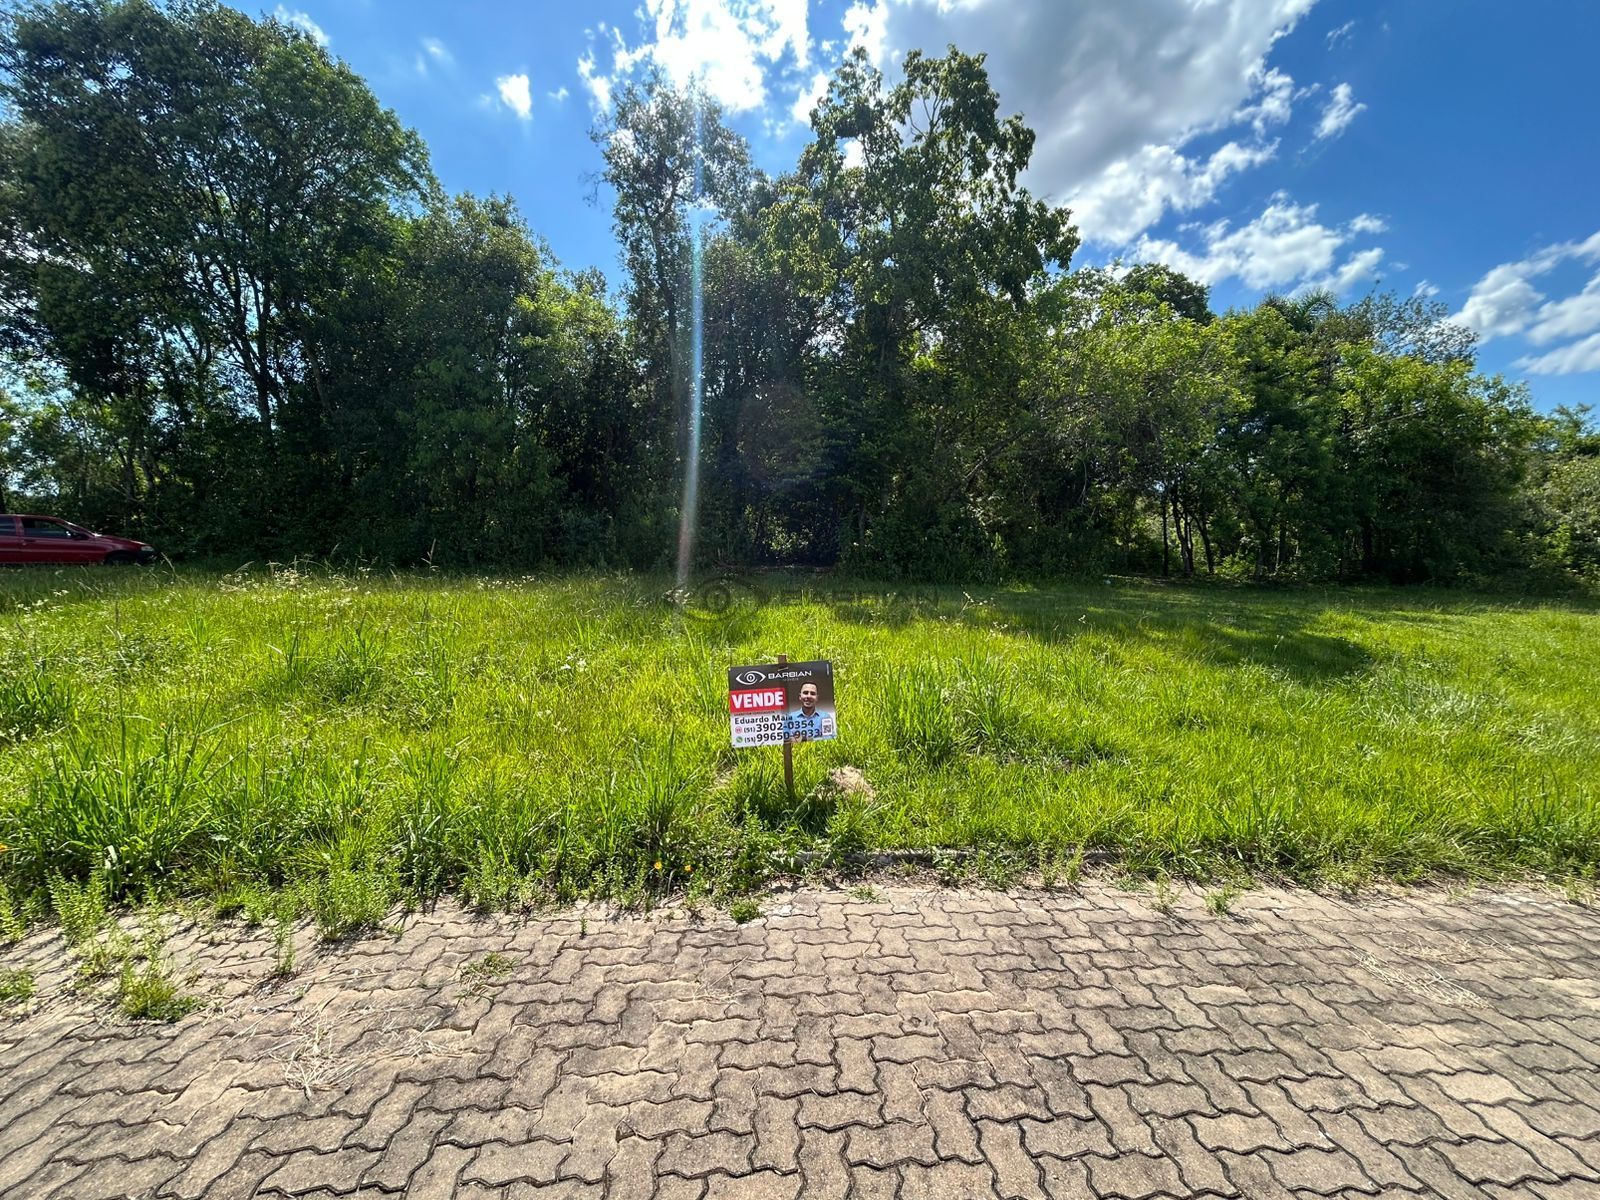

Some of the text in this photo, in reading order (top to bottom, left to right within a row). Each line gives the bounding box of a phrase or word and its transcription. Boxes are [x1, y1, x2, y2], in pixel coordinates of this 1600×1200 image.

[768, 670, 812, 680] BARBIAN
[731, 691, 784, 709] VENDE
[734, 716, 769, 725] Eduardo
[756, 720, 814, 732] 3902-0354
